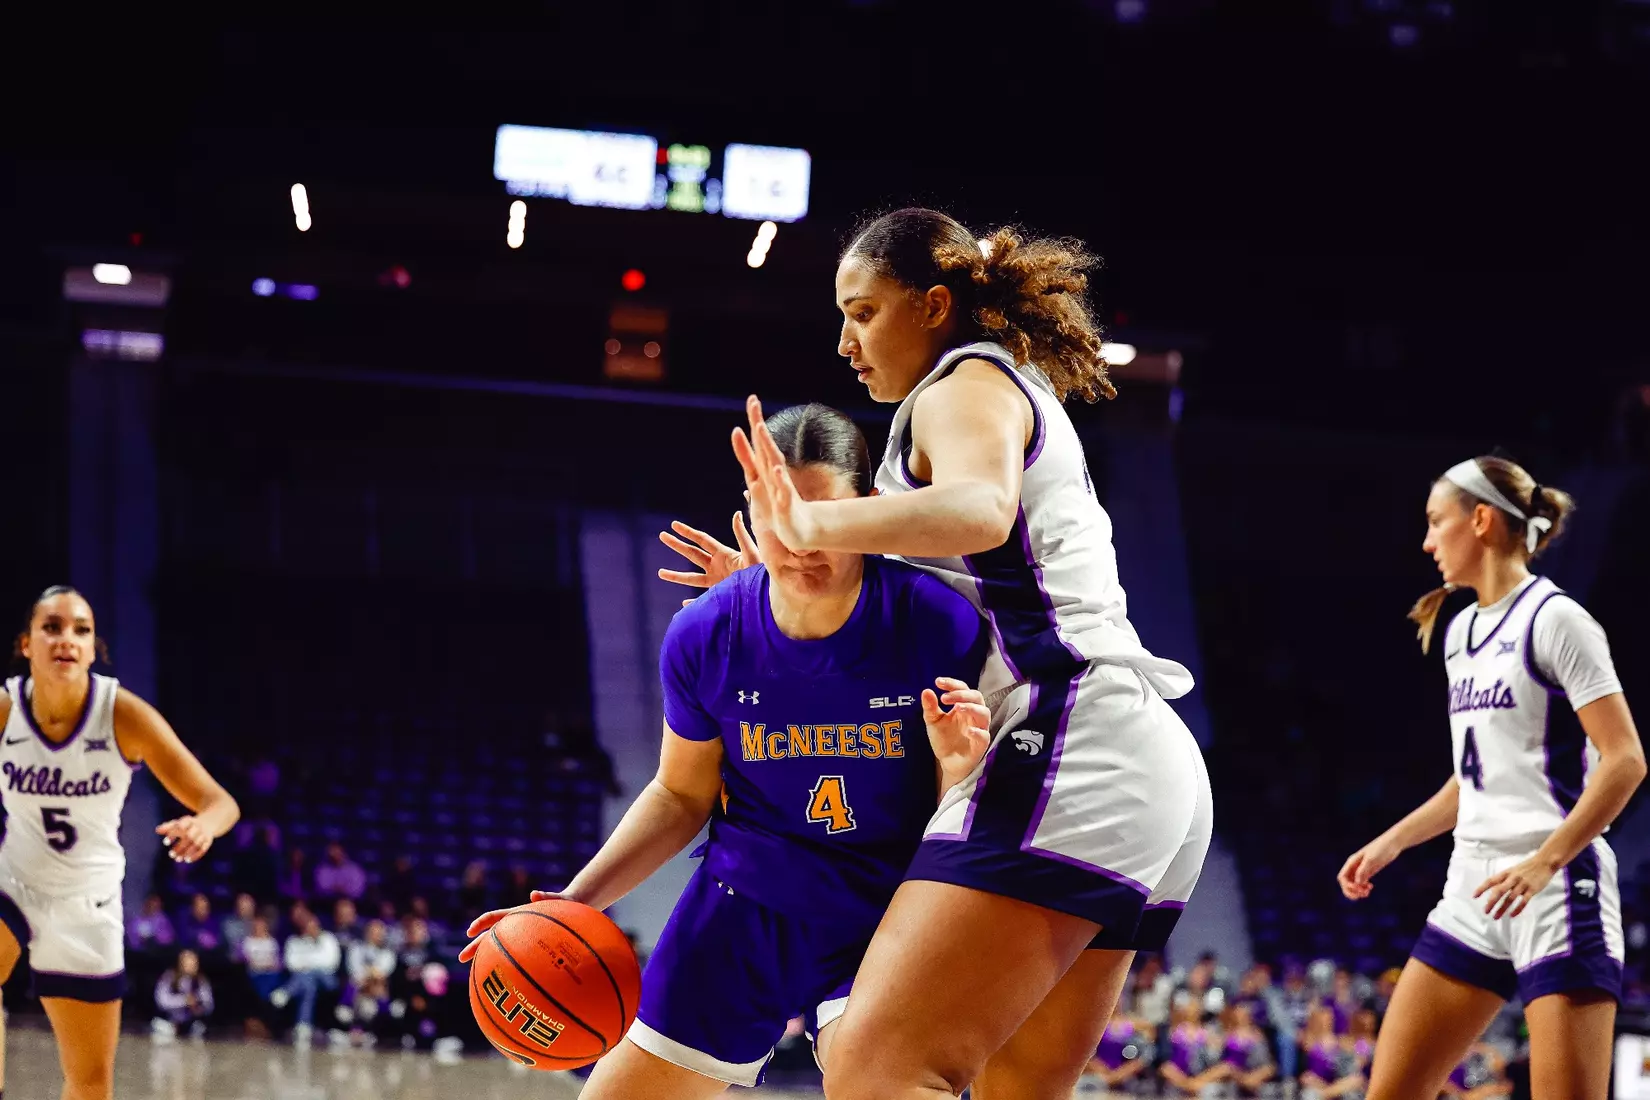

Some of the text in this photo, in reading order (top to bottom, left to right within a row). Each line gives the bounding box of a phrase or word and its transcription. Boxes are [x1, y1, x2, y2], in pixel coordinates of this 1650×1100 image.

[869, 695, 915, 709] SLC
[739, 719, 905, 761] McNEESE
[1460, 725, 1485, 791] 4
[2, 761, 111, 797] Wildcats
[805, 775, 857, 835] 4
[40, 806, 78, 853] 5
[482, 968, 561, 1049] ELITE
